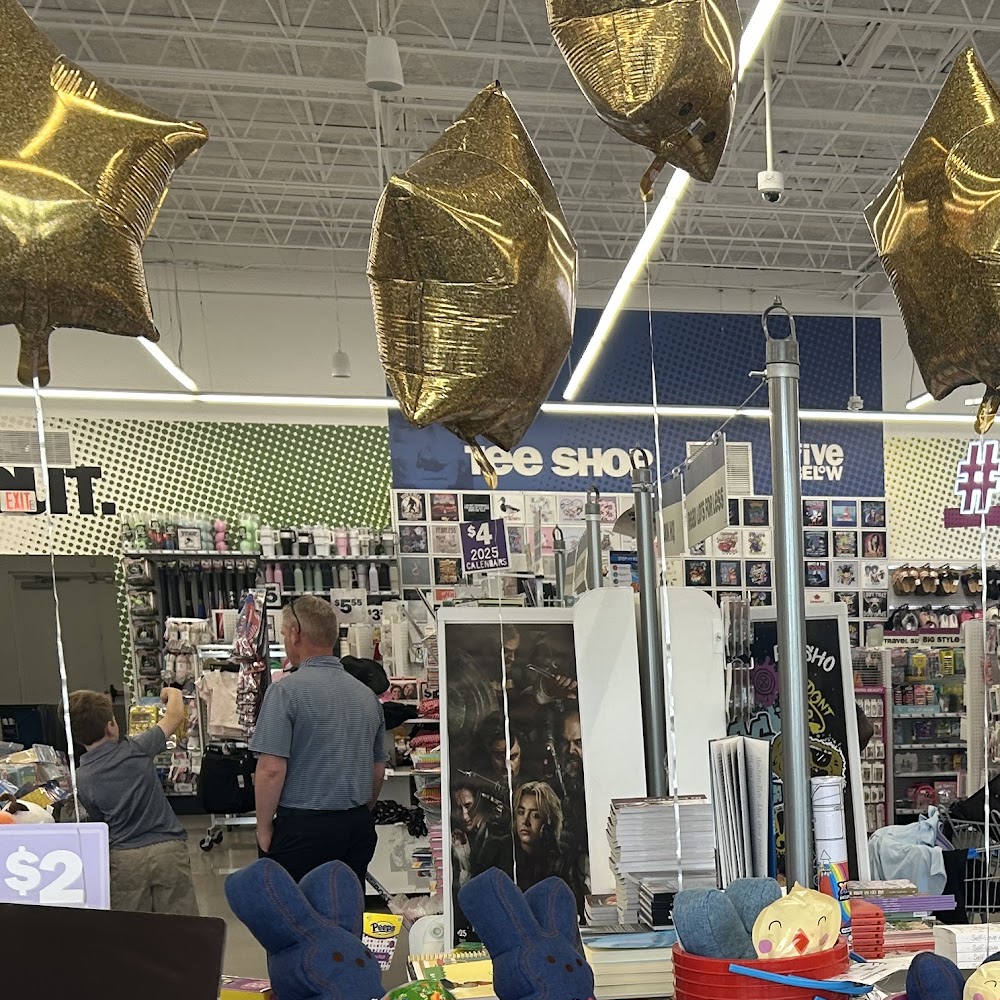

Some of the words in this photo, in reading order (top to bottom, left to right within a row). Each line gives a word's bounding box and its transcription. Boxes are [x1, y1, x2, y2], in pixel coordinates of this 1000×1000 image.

[5, 491, 30, 510] EXIT
[467, 522, 493, 545] $4
[470, 546, 499, 561] 2025
[466, 558, 508, 570] CALENDARS
[4, 845, 84, 904] $2
[371, 923, 396, 933] Peeps
